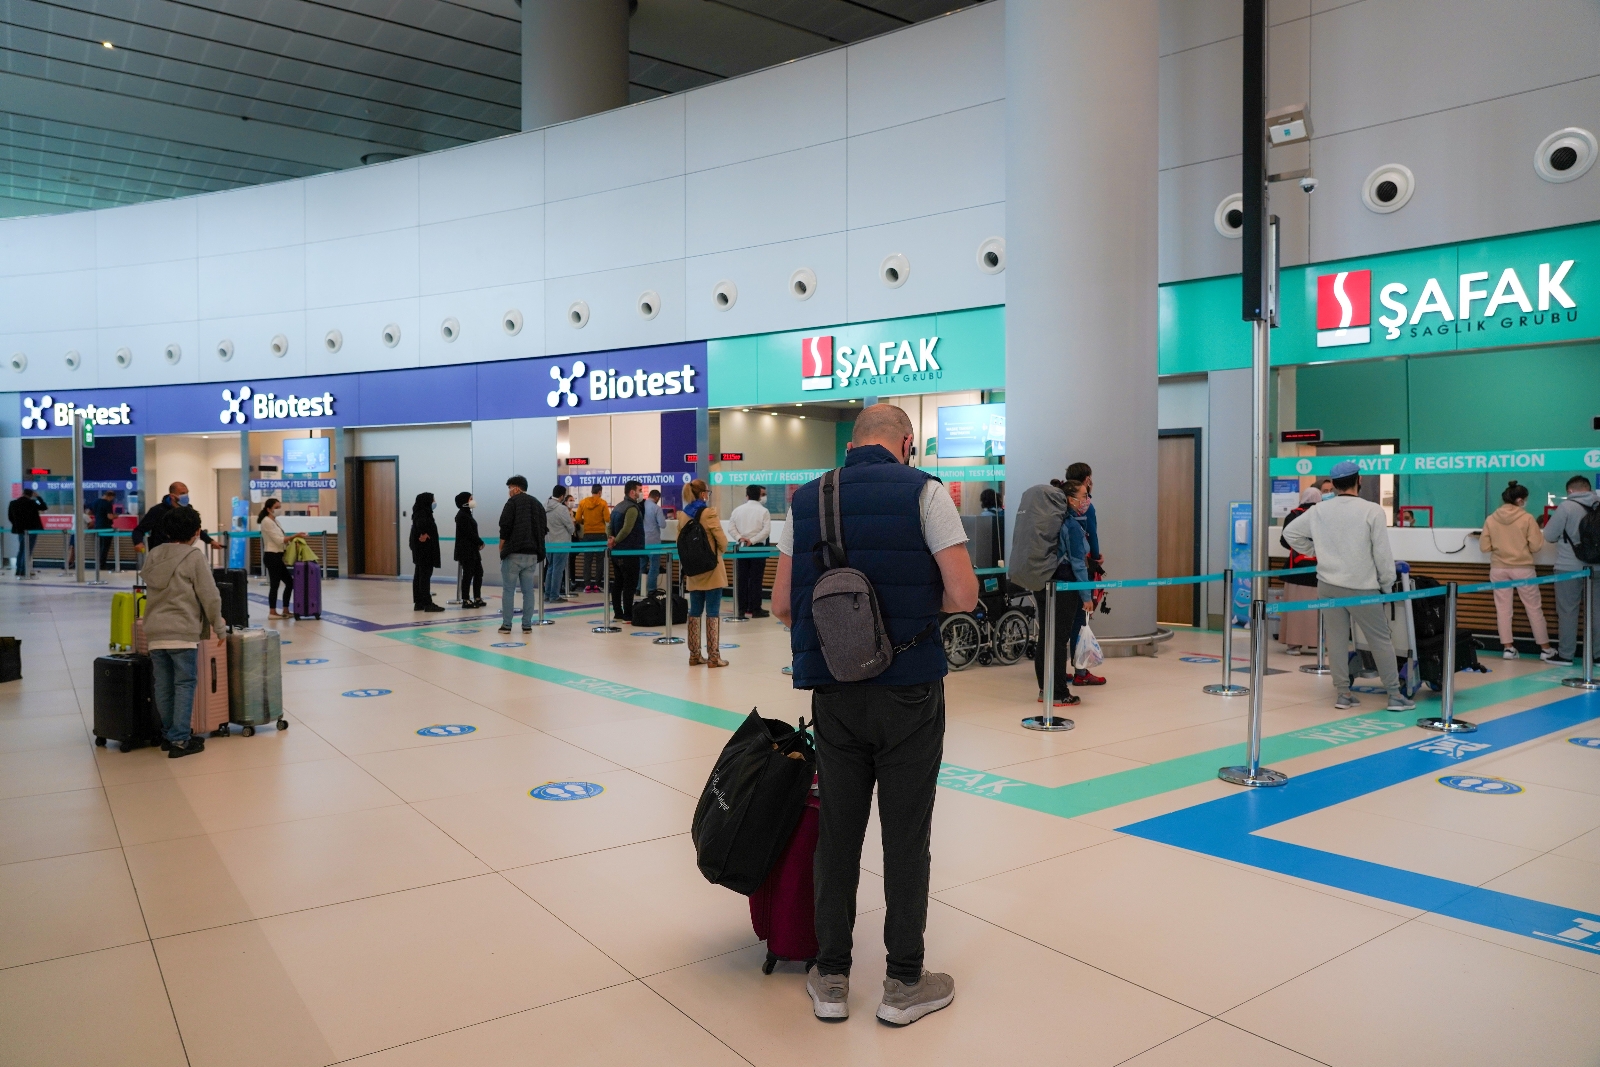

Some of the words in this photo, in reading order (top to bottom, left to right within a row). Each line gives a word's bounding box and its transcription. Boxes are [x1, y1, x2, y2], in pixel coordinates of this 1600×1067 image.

[1378, 259, 1577, 340] ŞAFAK
[1410, 318, 1486, 338] SAĞLIK
[1500, 310, 1578, 329] GRUBU
[836, 336, 941, 387] ŞAFAK
[590, 364, 696, 401] Biotest
[855, 375, 896, 387] SAĞLIK
[903, 371, 943, 382] GRUBU
[253, 392, 334, 419] Biotest
[969, 469, 985, 477] TEST
[986, 469, 1005, 477] SONU
[1346, 458, 1393, 471] AYIT
[1414, 453, 1545, 470] REGISTRATION
[293, 480, 307, 488] TEST
[307, 480, 329, 488] RESULT
[580, 476, 596, 485] TEST
[597, 475, 617, 484] KAYIT
[622, 474, 675, 484] REGISTRATION
[729, 473, 748, 482] TEST
[750, 473, 773, 481] KAYIT
[939, 766, 1028, 794] FAK
